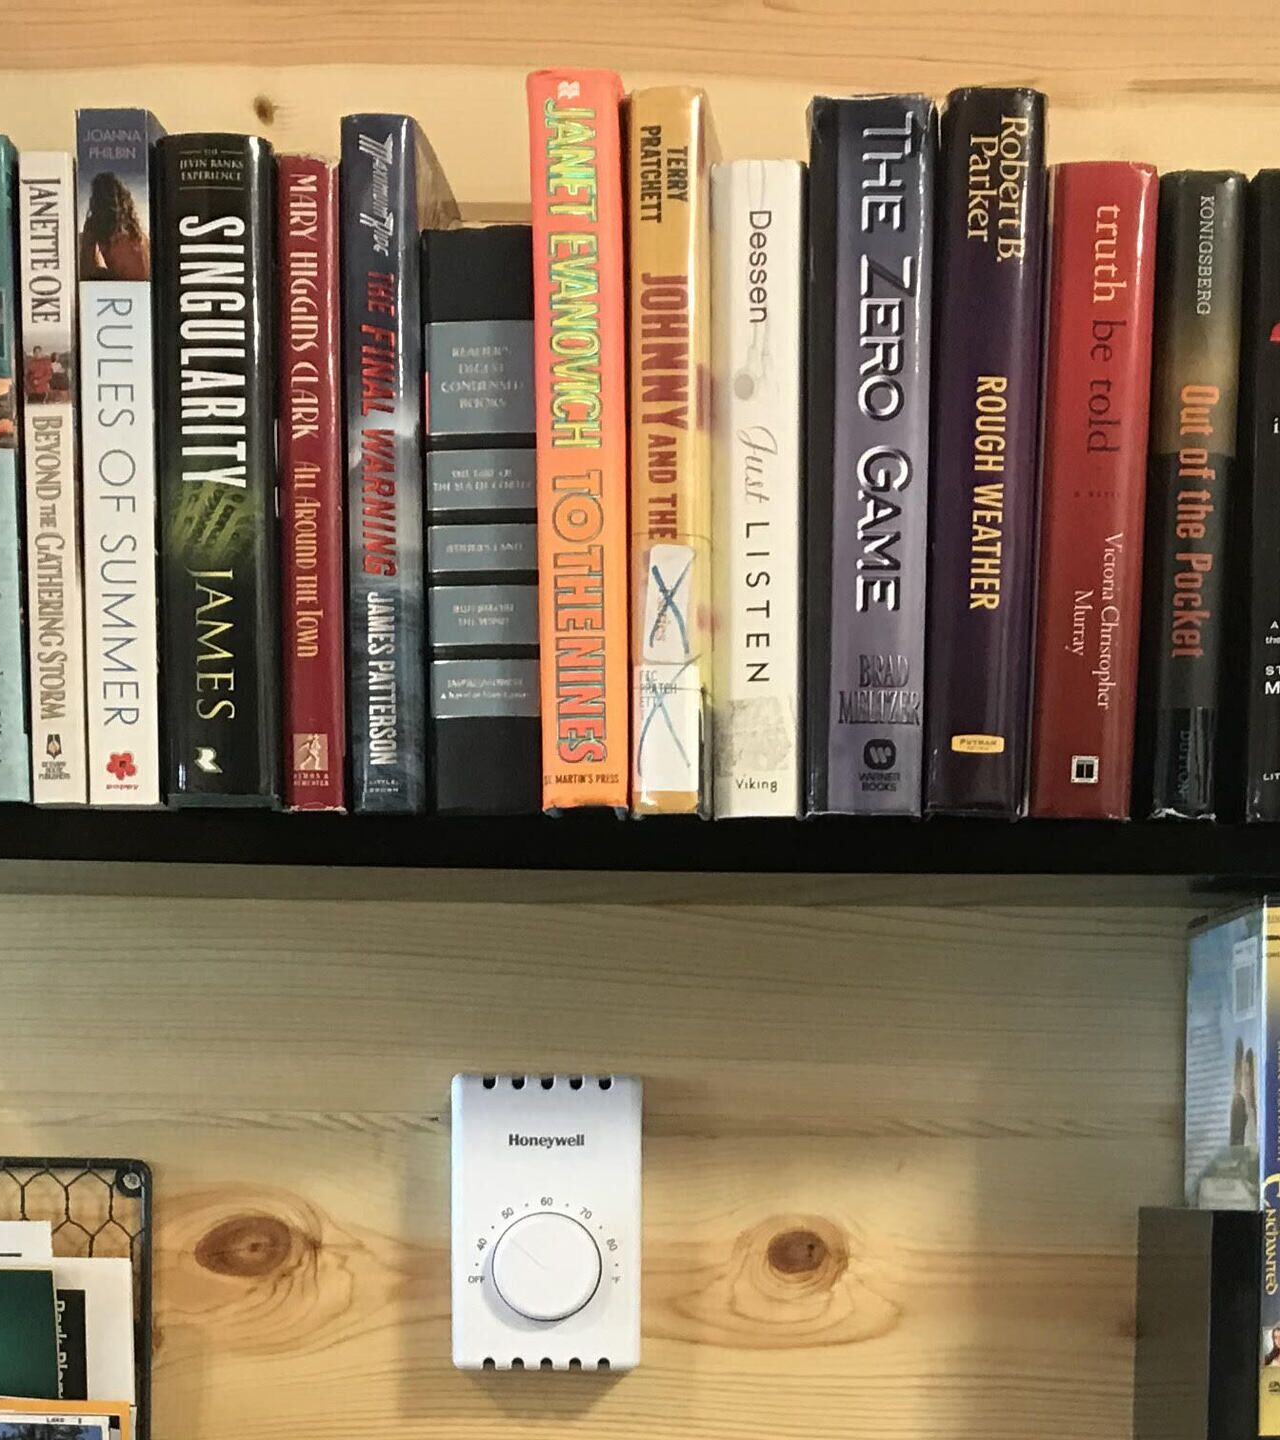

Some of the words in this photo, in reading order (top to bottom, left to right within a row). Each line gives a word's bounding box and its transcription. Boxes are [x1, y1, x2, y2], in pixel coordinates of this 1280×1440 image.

[84, 129, 141, 142] JOANNA
[544, 99, 598, 222] JANET
[862, 111, 916, 232] THE
[998, 116, 1029, 227] Robert
[289, 173, 318, 238] MARY
[640, 125, 663, 223] PRATCHETT
[667, 146, 689, 203] TERRY
[967, 134, 999, 243] Parker
[22, 177, 61, 271] JANETTE
[996, 239, 1025, 264] B.
[1092, 203, 1127, 303] truth
[1196, 196, 1215, 315] KONIGSBERG
[28, 275, 62, 324] OKE
[289, 251, 319, 353] HIGGINS
[368, 272, 394, 316] THE
[749, 211, 772, 324] Dessen
[96, 297, 134, 427] RULES
[179, 215, 247, 488] SINGULARITY
[360, 324, 395, 417] FINAL
[548, 231, 602, 449] EVANOVICH
[640, 272, 689, 428] JOHNNY
[859, 254, 916, 421] ZERO
[1090, 320, 1127, 362] be
[291, 361, 319, 440] CLARK
[973, 375, 1008, 471] ROUGH
[1086, 380, 1120, 454] told
[1180, 384, 1219, 436] Out
[32, 416, 63, 501] BEYOND
[98, 449, 136, 514] OF
[648, 434, 677, 483] AND
[737, 426, 778, 503] Just
[1178, 448, 1216, 481] of
[361, 429, 398, 577] WARNING
[552, 470, 605, 542] TO
[649, 494, 678, 540] THE
[856, 446, 913, 612] GAME
[1175, 490, 1214, 540] the
[969, 483, 1005, 610] WEATHER
[1102, 533, 1123, 597] Victoria
[35, 532, 65, 648] GATHERING
[367, 591, 394, 656] JAMES
[553, 545, 606, 632] THE
[745, 521, 771, 683] LISTEN
[1064, 590, 1094, 657] Murray
[1171, 553, 1212, 659] Pocket
[1271, 621, 1279, 629] A
[99, 534, 139, 726] SUMMER
[186, 569, 235, 720] JAMES
[1092, 601, 1119, 710] Christopher
[1265, 635, 1280, 644] the
[40, 651, 66, 720] STORM
[555, 636, 608, 764] NINES
[838, 691, 921, 725] MELTZER
[859, 655, 909, 687] BRAD
[368, 661, 398, 766] PATTERSON
[736, 774, 777, 792] Viking
[858, 772, 900, 781] WARNER
[861, 783, 897, 792] BOOKS
[509, 1134, 585, 1149] Honeywell
[502, 1207, 514, 1219] 50
[541, 1197, 553, 1206] 60
[580, 1207, 592, 1220] 70
[468, 1276, 485, 1284] OFF
[477, 1238, 487, 1251] 40
[606, 1238, 618, 1251] 80
